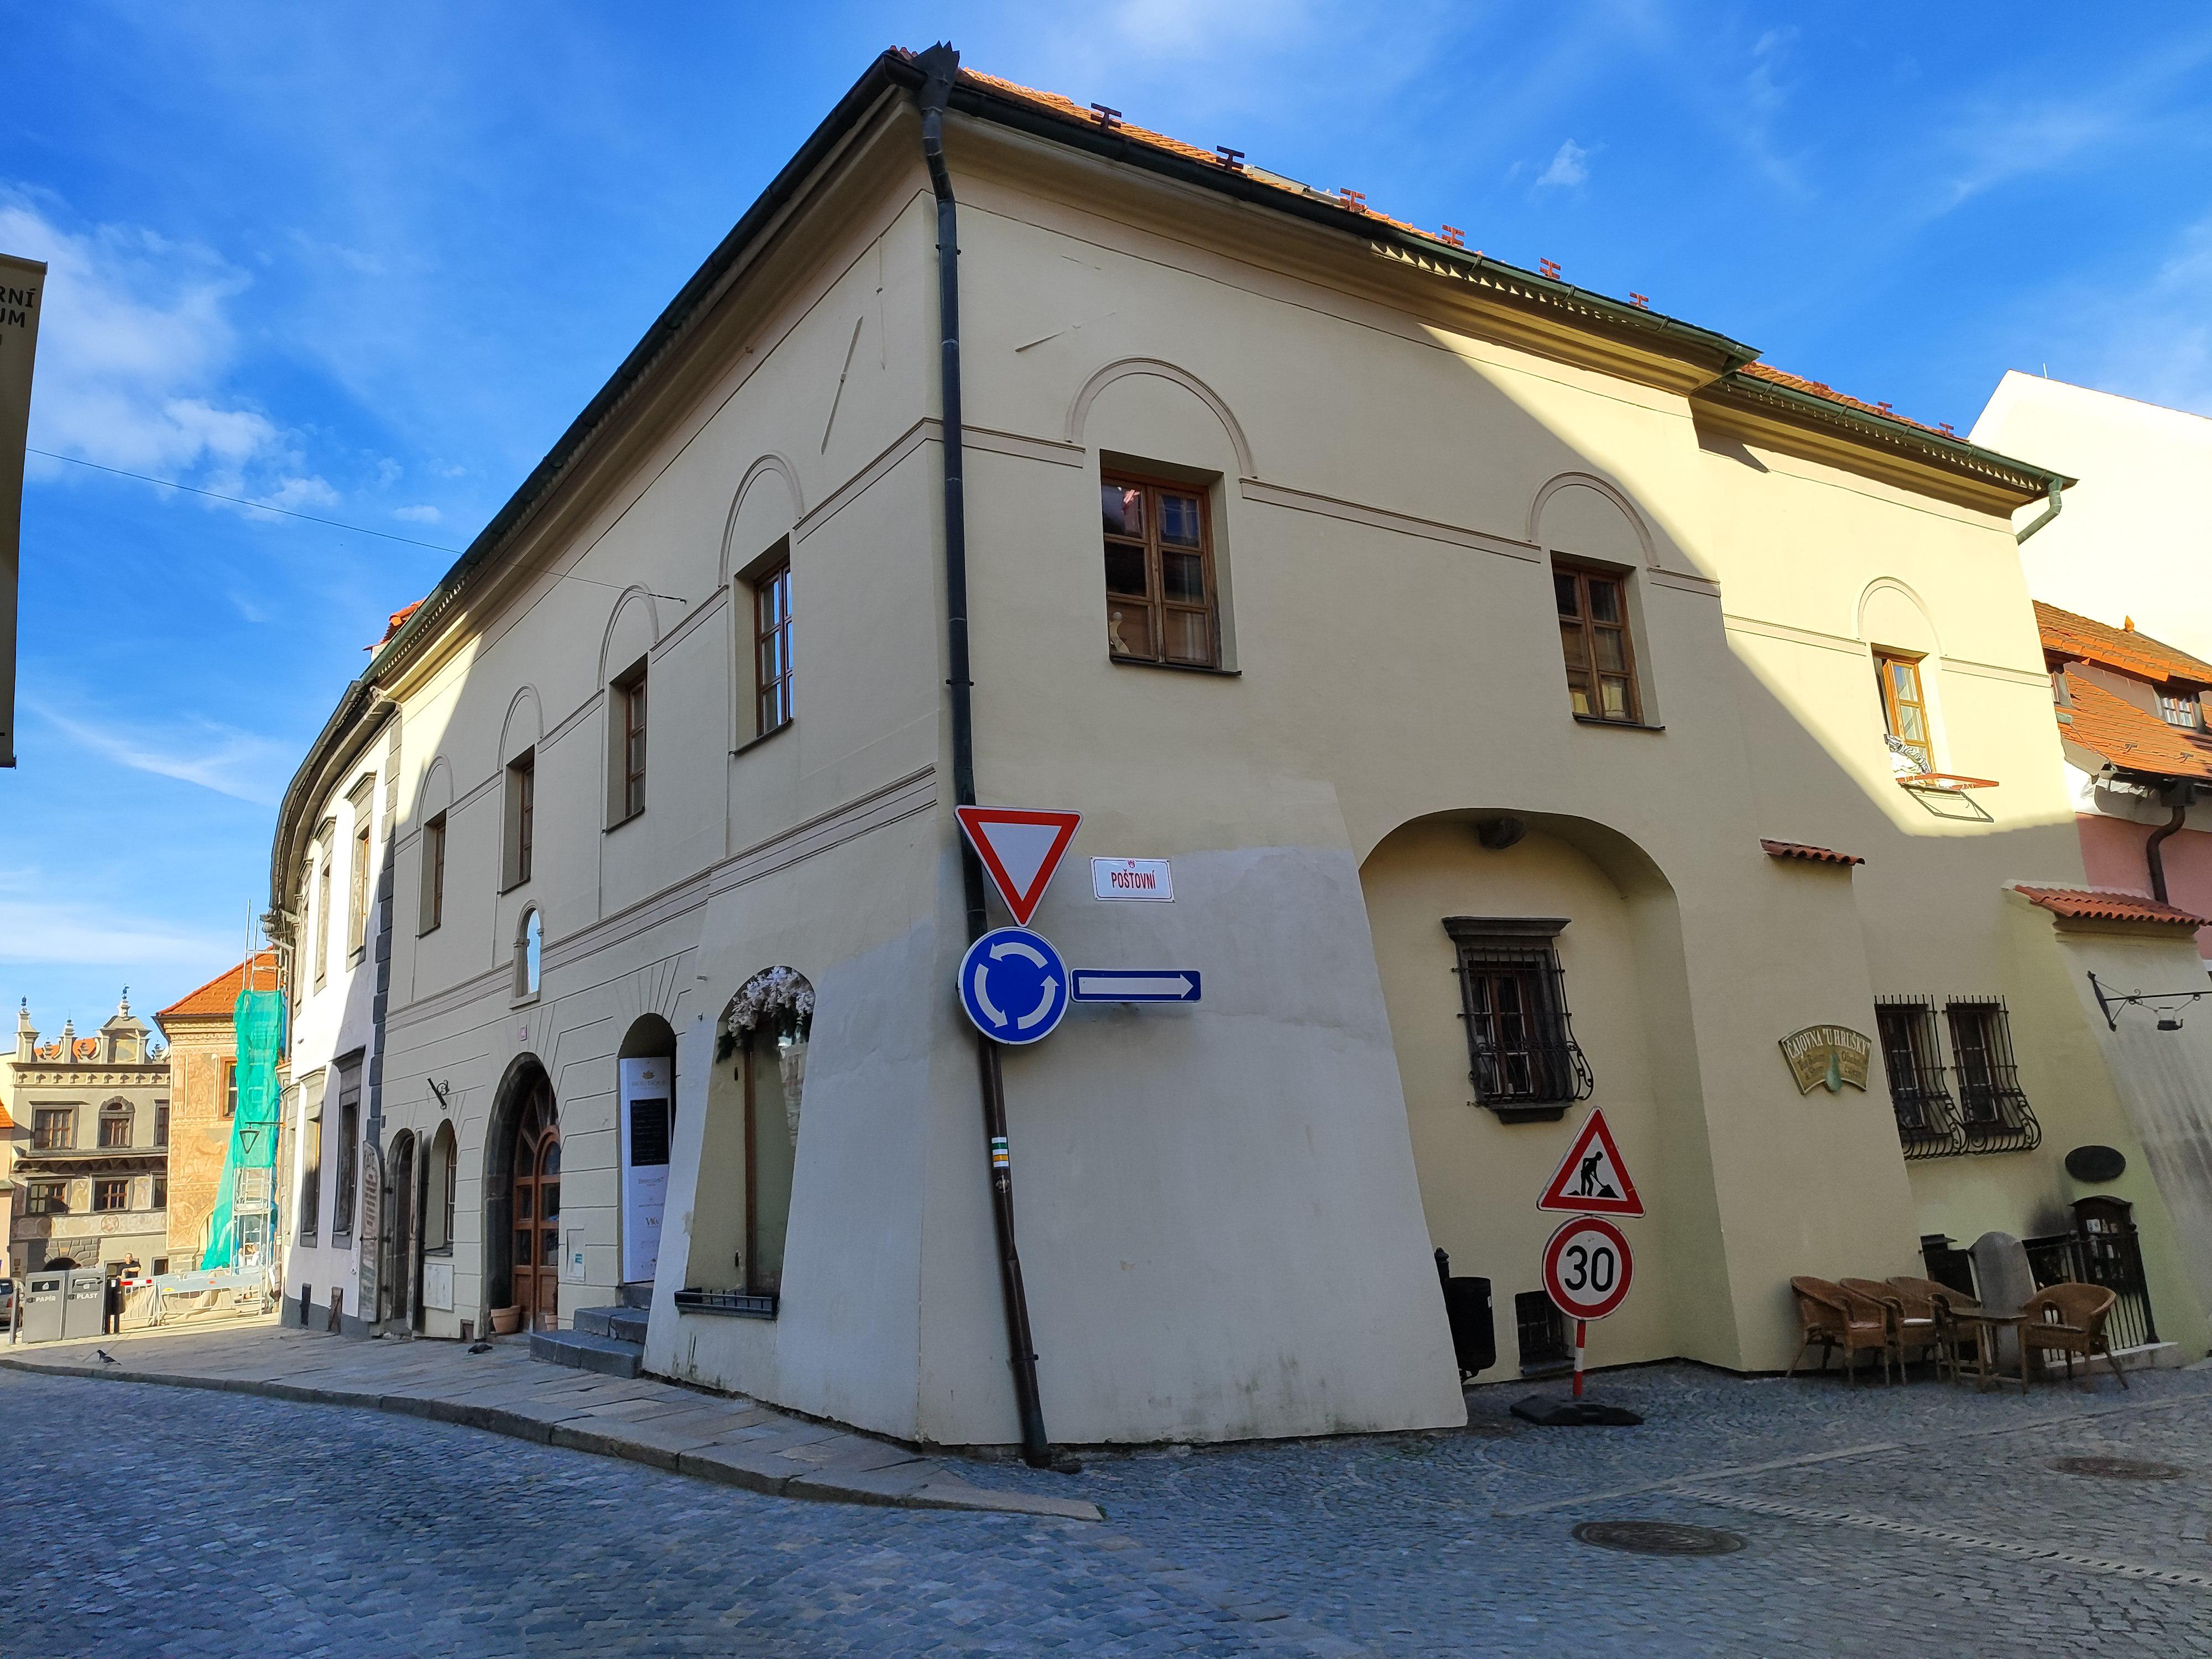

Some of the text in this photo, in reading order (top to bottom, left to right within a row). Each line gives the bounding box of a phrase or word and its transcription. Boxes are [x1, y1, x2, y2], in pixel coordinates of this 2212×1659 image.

[1110, 868, 1156, 889] POŠTOVNÍ
[1786, 1029, 1824, 1059] ČAJOVNA
[1564, 1245, 1614, 1292] 30
